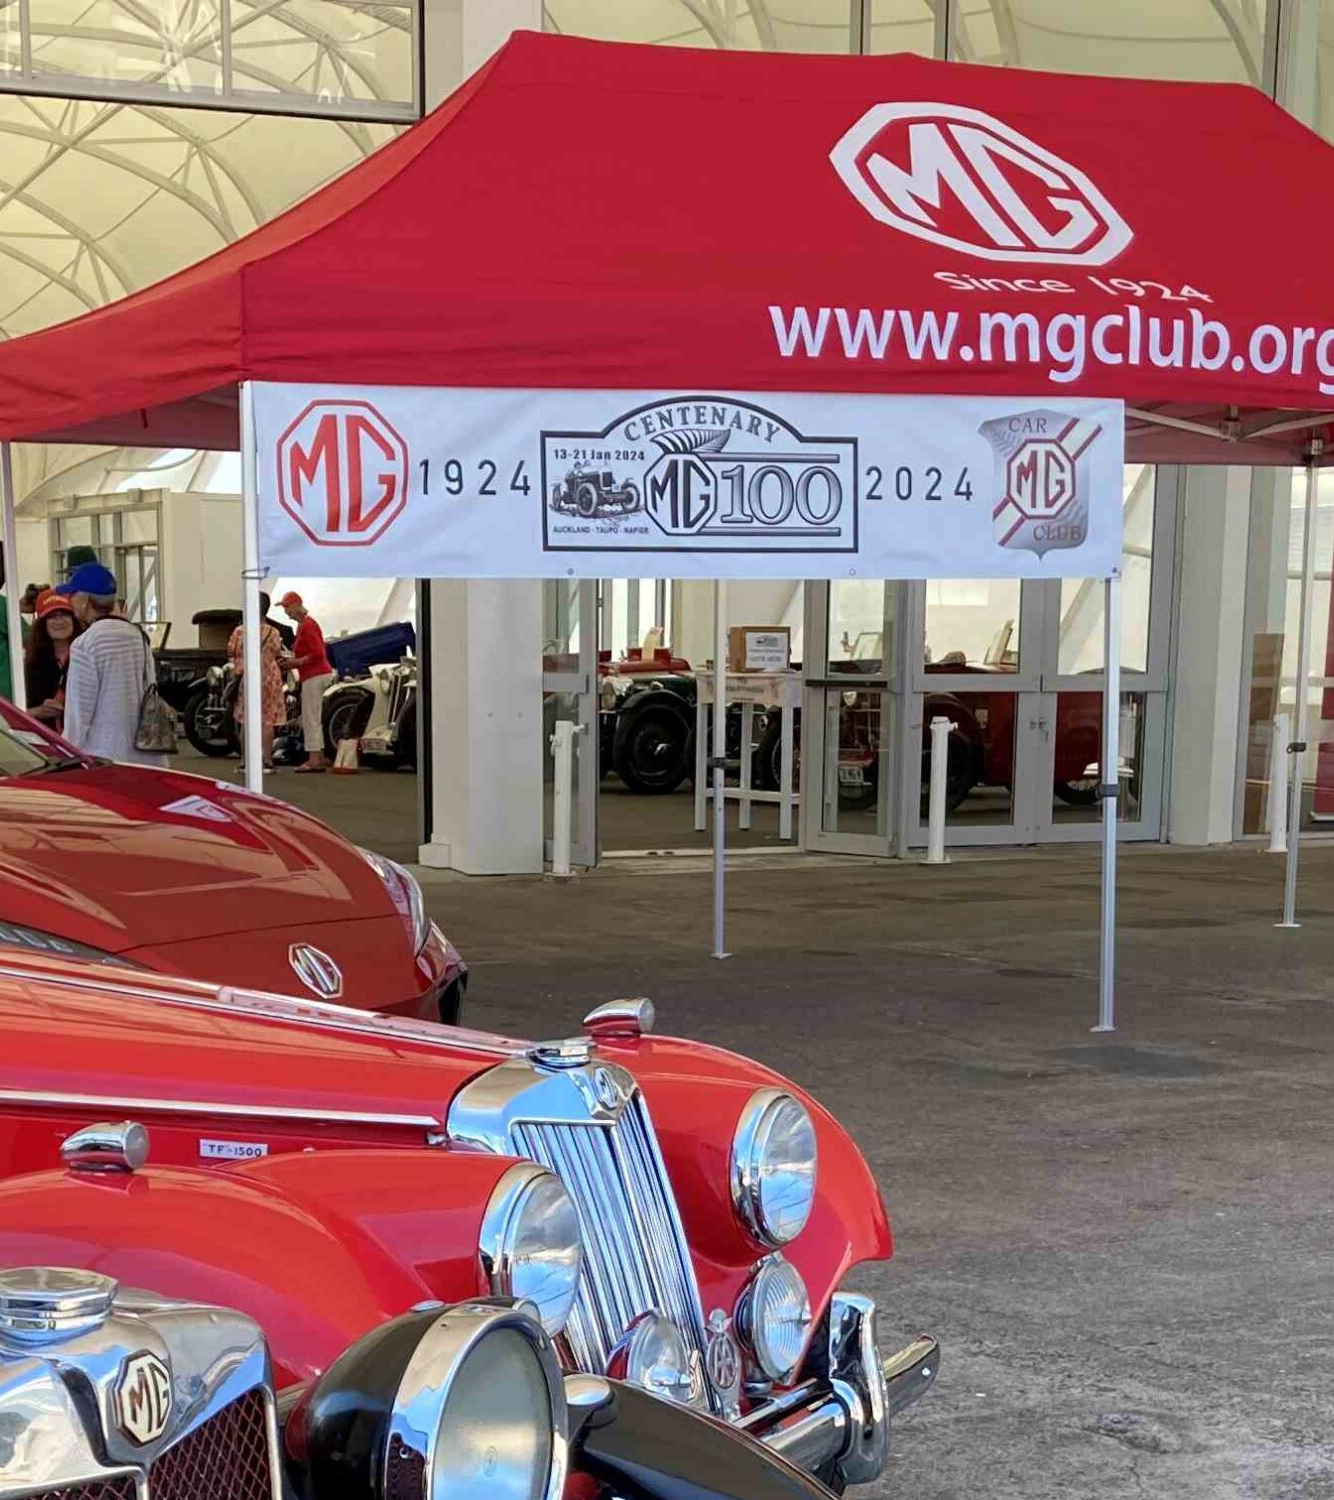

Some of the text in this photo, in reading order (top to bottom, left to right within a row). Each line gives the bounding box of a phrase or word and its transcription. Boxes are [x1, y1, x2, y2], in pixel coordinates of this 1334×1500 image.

[865, 122, 1099, 250] MG
[933, 271, 1215, 303] Since 1924
[623, 405, 782, 443] CENTENARY
[1008, 417, 1047, 433] CAR
[288, 413, 397, 533] MG
[614, 450, 645, 461] 2024
[419, 459, 531, 496] 1924
[649, 458, 711, 529] MG
[721, 464, 843, 526] 100
[865, 465, 973, 502] 2024
[1016, 449, 1066, 509] MG
[1033, 524, 1082, 541] CLUB
[128, 1361, 170, 1434] MG
